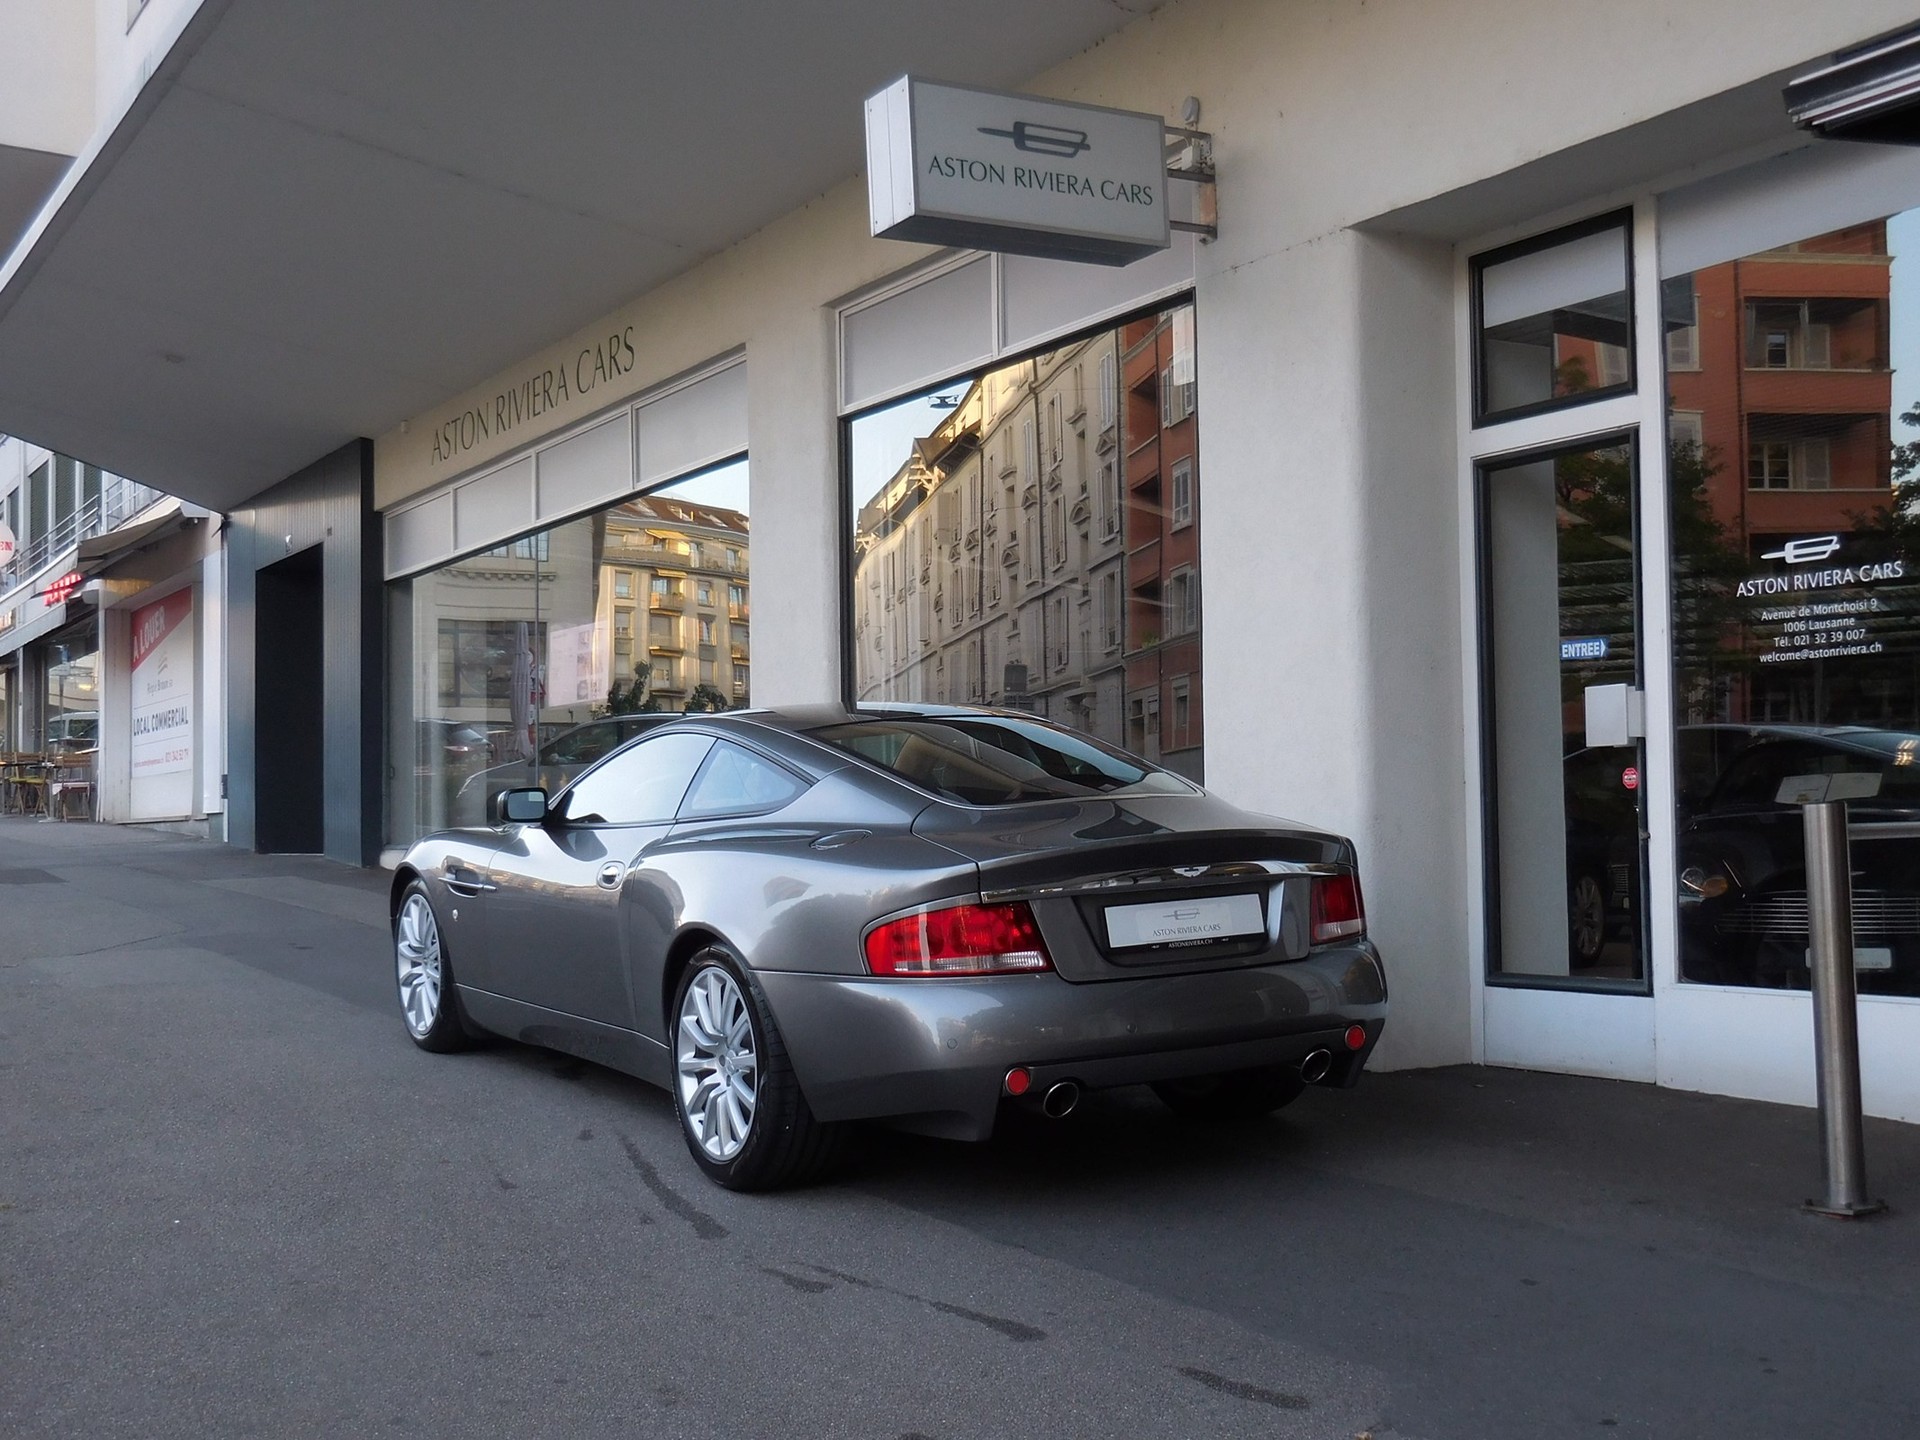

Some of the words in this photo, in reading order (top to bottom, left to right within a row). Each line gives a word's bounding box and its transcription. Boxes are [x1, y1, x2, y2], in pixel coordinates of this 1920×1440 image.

[928, 155, 1005, 185] ASTON
[1014, 167, 1095, 198] RIVIERA
[1100, 180, 1153, 206] CARS
[431, 402, 489, 466] ASTON
[496, 363, 570, 435] RIVIERA
[576, 326, 635, 394] CARS
[1736, 577, 1788, 598] ASTON
[1794, 568, 1854, 590] RIVIERA
[1859, 561, 1903, 582] CARS
[1761, 609, 1796, 622] Avenue
[1798, 606, 1811, 617] de
[1813, 599, 1867, 615] Montchoisi
[1870, 598, 1877, 609] 9
[140, 605, 166, 656] LOUER
[1783, 621, 1806, 633] 1006
[1808, 617, 1855, 631] Lausanne
[1773, 635, 1791, 647] Tél.
[1794, 634, 1810, 646] 021
[1814, 633, 1827, 644] 32
[1830, 631, 1843, 643] 39
[1846, 629, 1866, 641] 007
[1562, 641, 1600, 658] ENTREE
[1759, 642, 1882, 663] welcome@astonriviera.ch
[134, 716, 150, 736] LOCAL
[152, 706, 189, 732] COMMERCIAL
[1153, 927, 1176, 937] ASTON
[1177, 925, 1202, 935] RIVIERA
[1203, 923, 1221, 933] CARS
[1168, 939, 1213, 948] ASTONRIVIERA.CH
